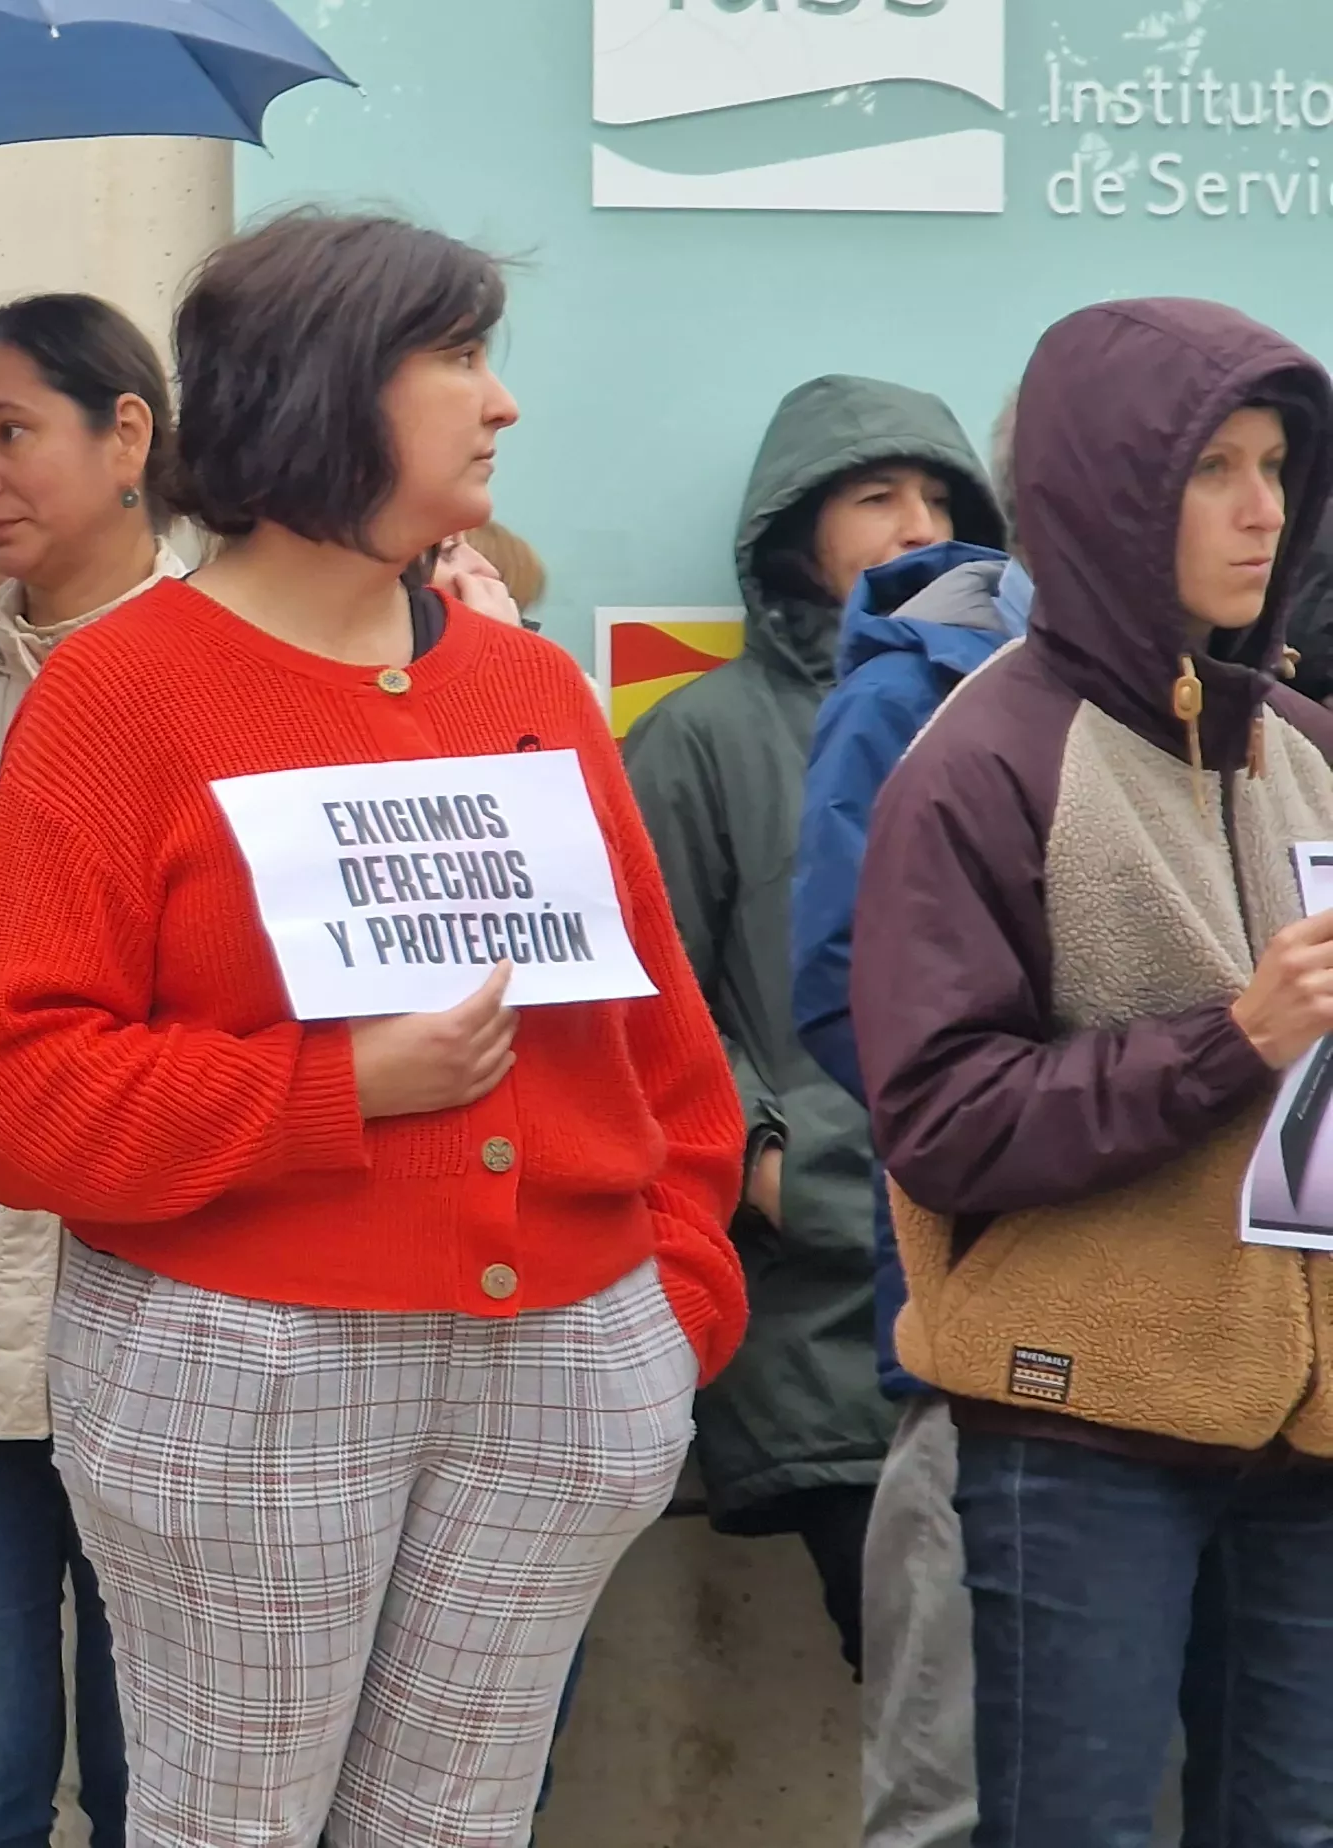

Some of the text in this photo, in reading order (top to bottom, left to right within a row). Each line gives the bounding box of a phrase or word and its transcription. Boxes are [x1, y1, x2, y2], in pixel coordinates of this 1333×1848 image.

[1049, 62, 1333, 126] Instituto
[1048, 152, 1333, 216] de Servi
[321, 793, 510, 847] EXIGIMOS
[338, 850, 534, 907] DERECHOS
[324, 902, 595, 968] Y PROTECCIÓN
